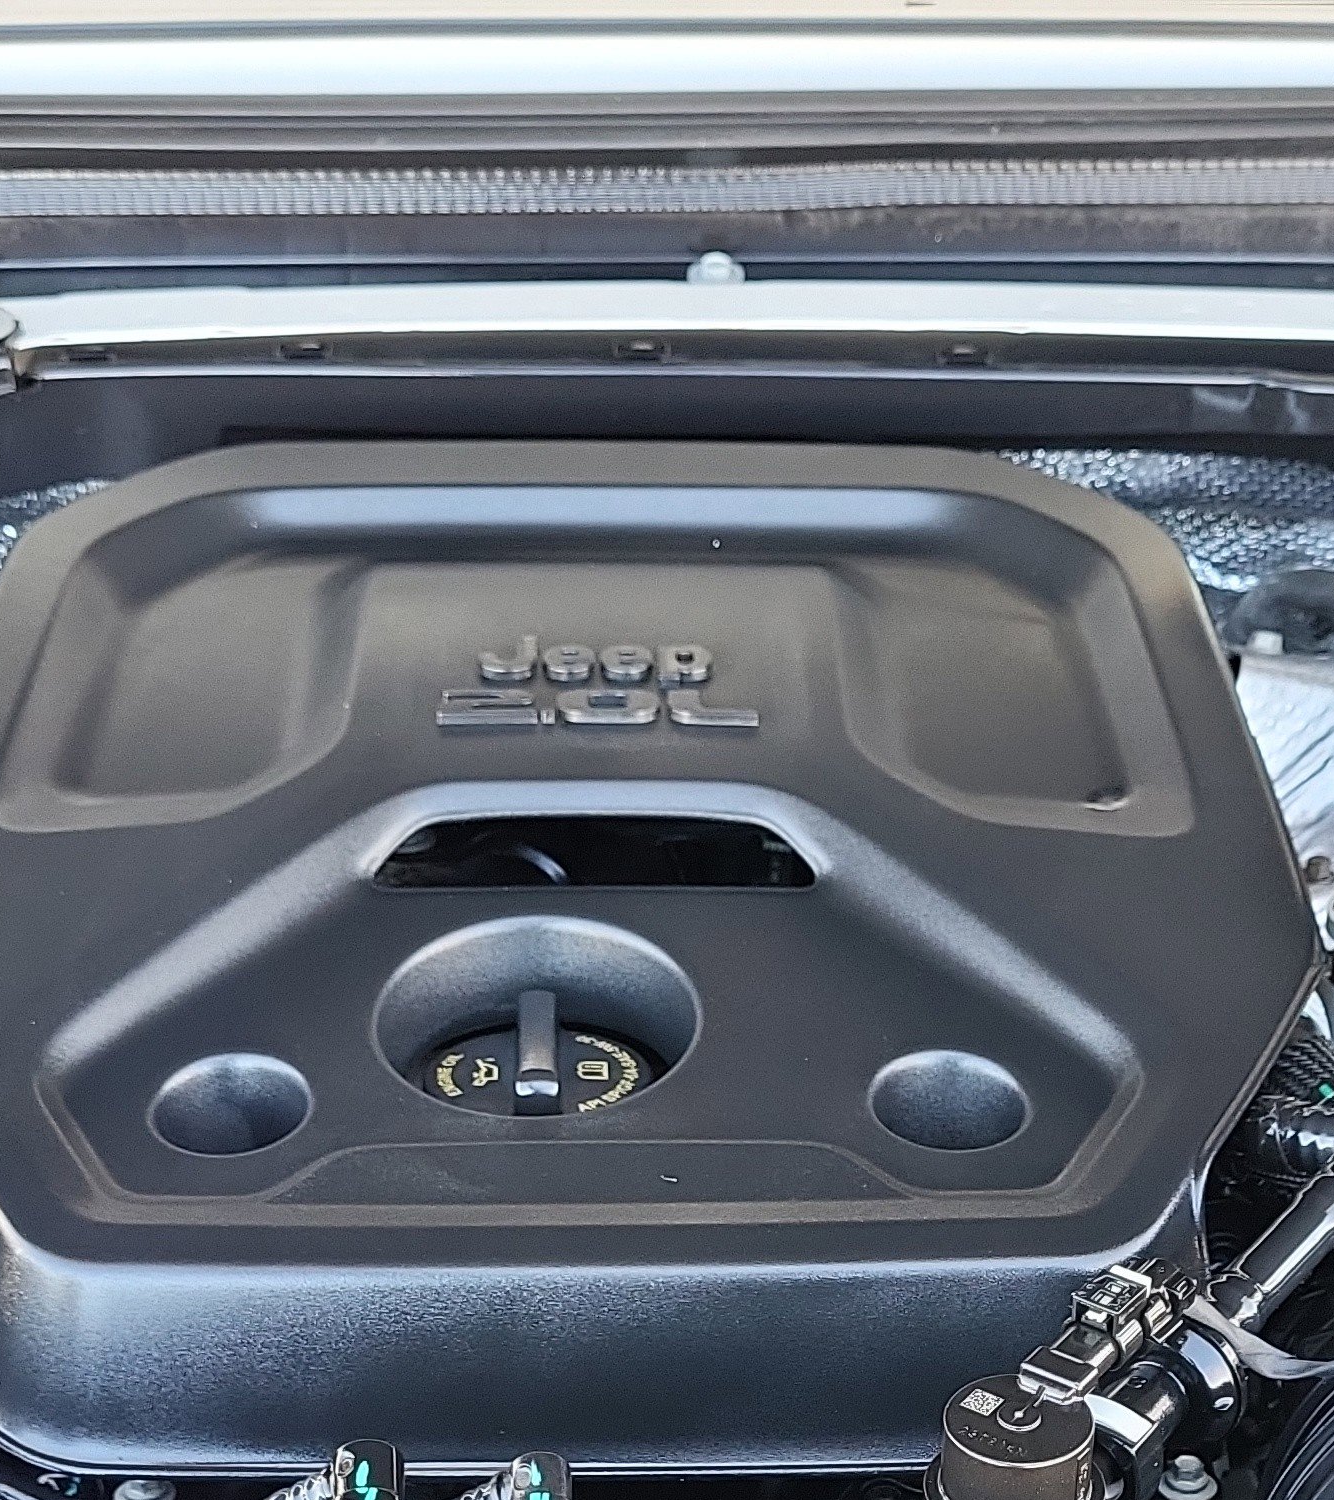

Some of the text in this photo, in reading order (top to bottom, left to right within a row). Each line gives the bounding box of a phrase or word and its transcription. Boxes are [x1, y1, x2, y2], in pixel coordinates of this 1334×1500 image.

[477, 634, 713, 688] Jeep
[435, 689, 760, 727] 2.0L
[441, 1053, 465, 1067] OIL
